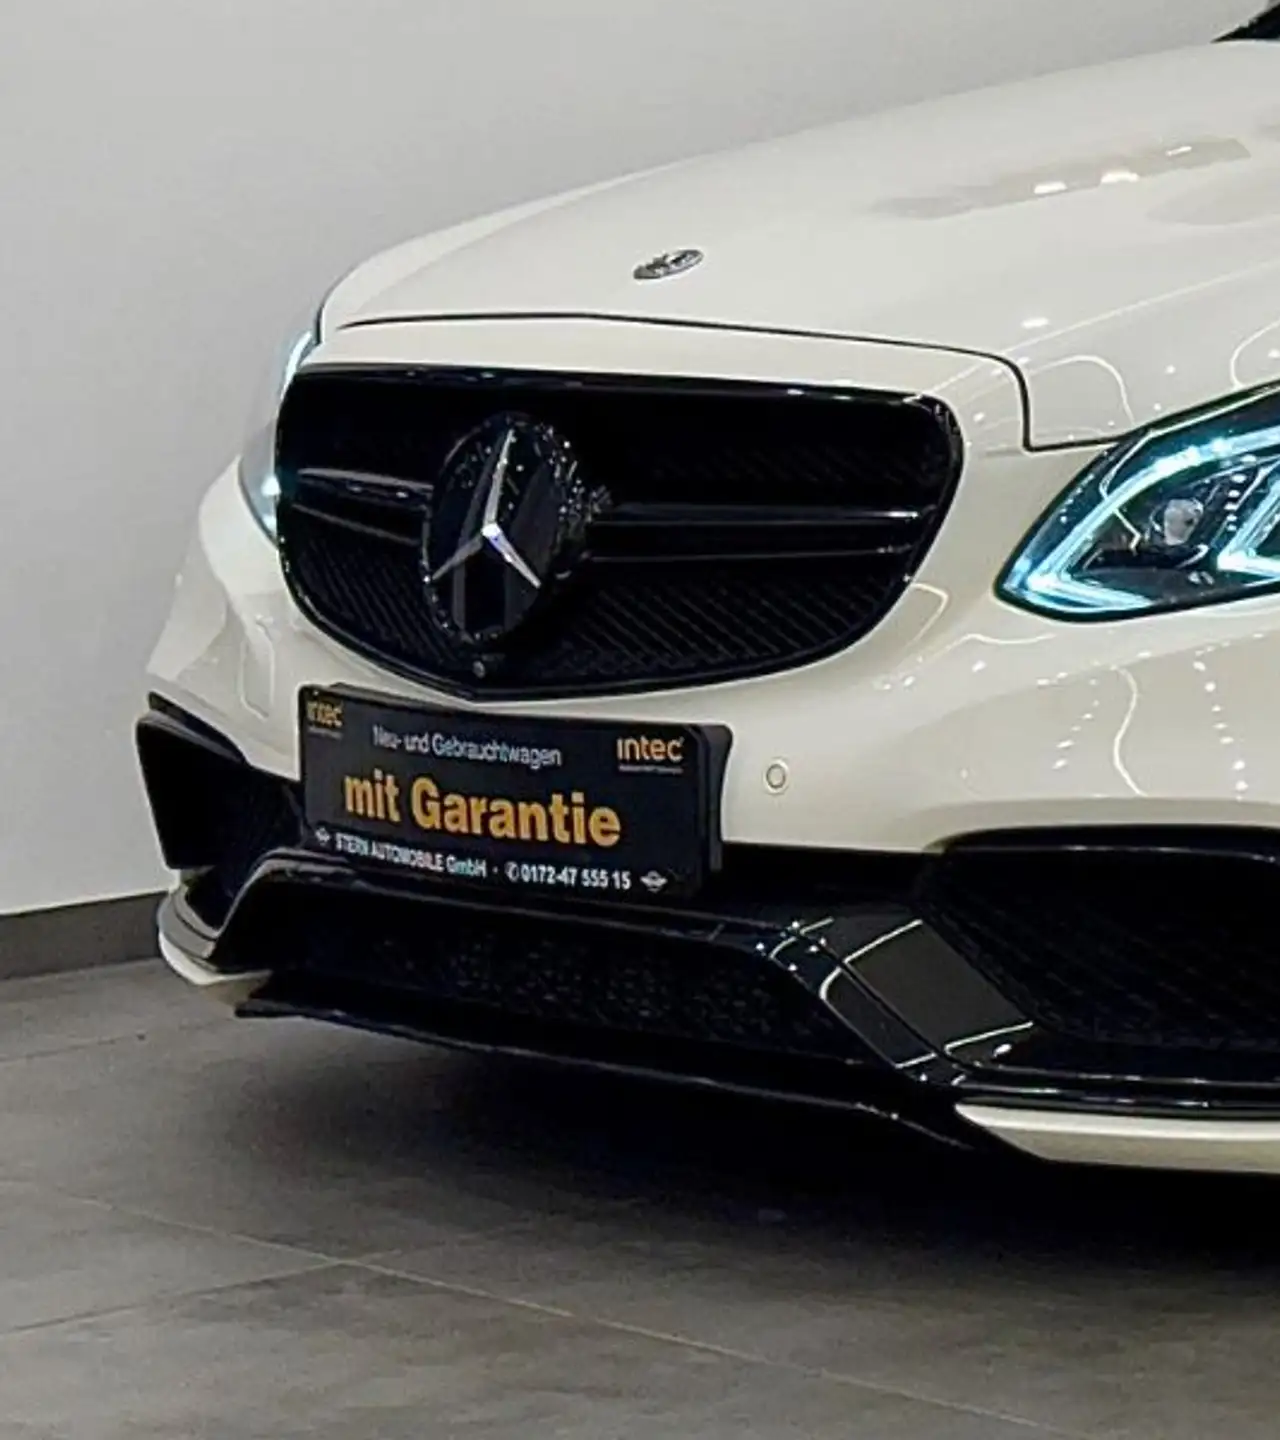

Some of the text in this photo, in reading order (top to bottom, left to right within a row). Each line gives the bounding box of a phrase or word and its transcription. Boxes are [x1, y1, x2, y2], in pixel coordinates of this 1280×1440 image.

[371, 724, 402, 750] Neu-
[404, 731, 430, 754] und
[431, 733, 562, 769] Gebrauchtwagen
[344, 767, 622, 848] mit Garantie
[335, 832, 632, 890] STERN AUTOMOBILE GmbH 0172-47 555 15
